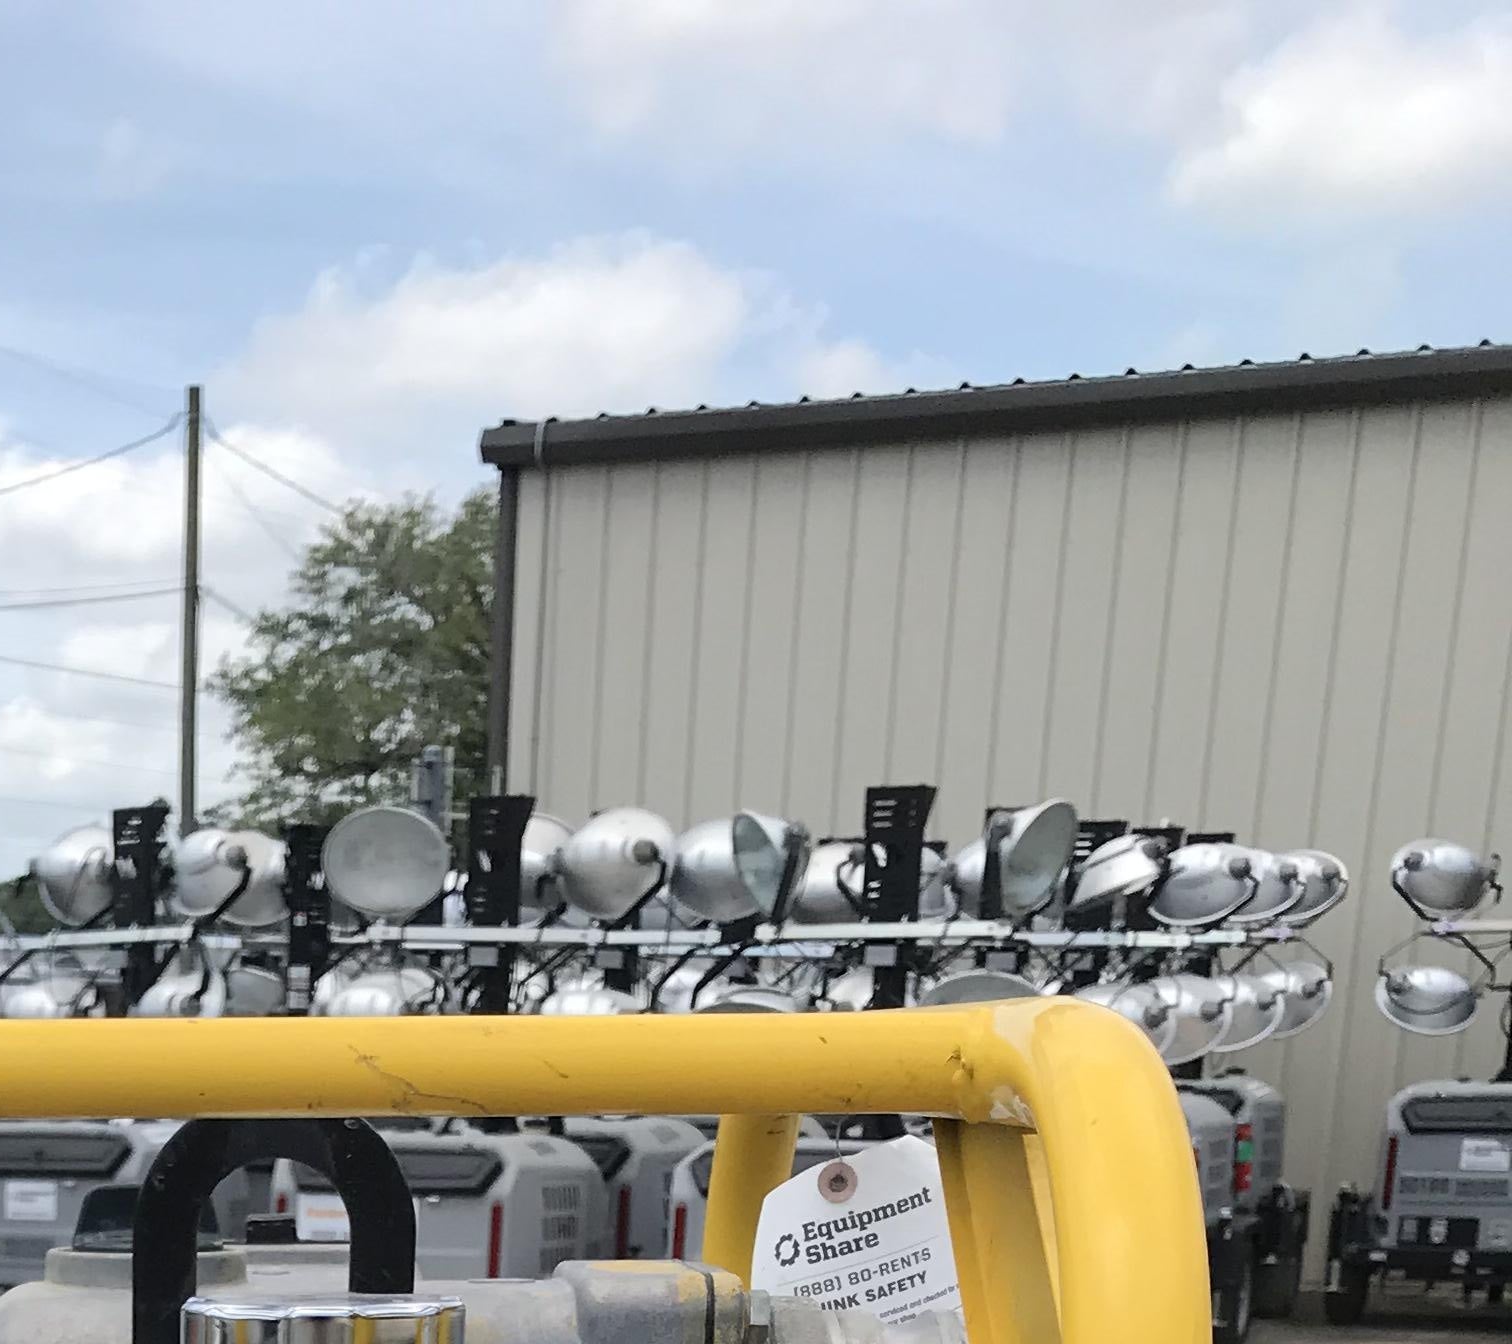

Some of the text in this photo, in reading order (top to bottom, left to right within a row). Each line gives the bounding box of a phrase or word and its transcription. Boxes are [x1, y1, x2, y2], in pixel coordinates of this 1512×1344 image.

[802, 1187, 932, 1242] Equipment
[805, 1232, 880, 1265] Share
[848, 1248, 931, 1285] 80-RENTS
[865, 1270, 928, 1302] SAFETY
